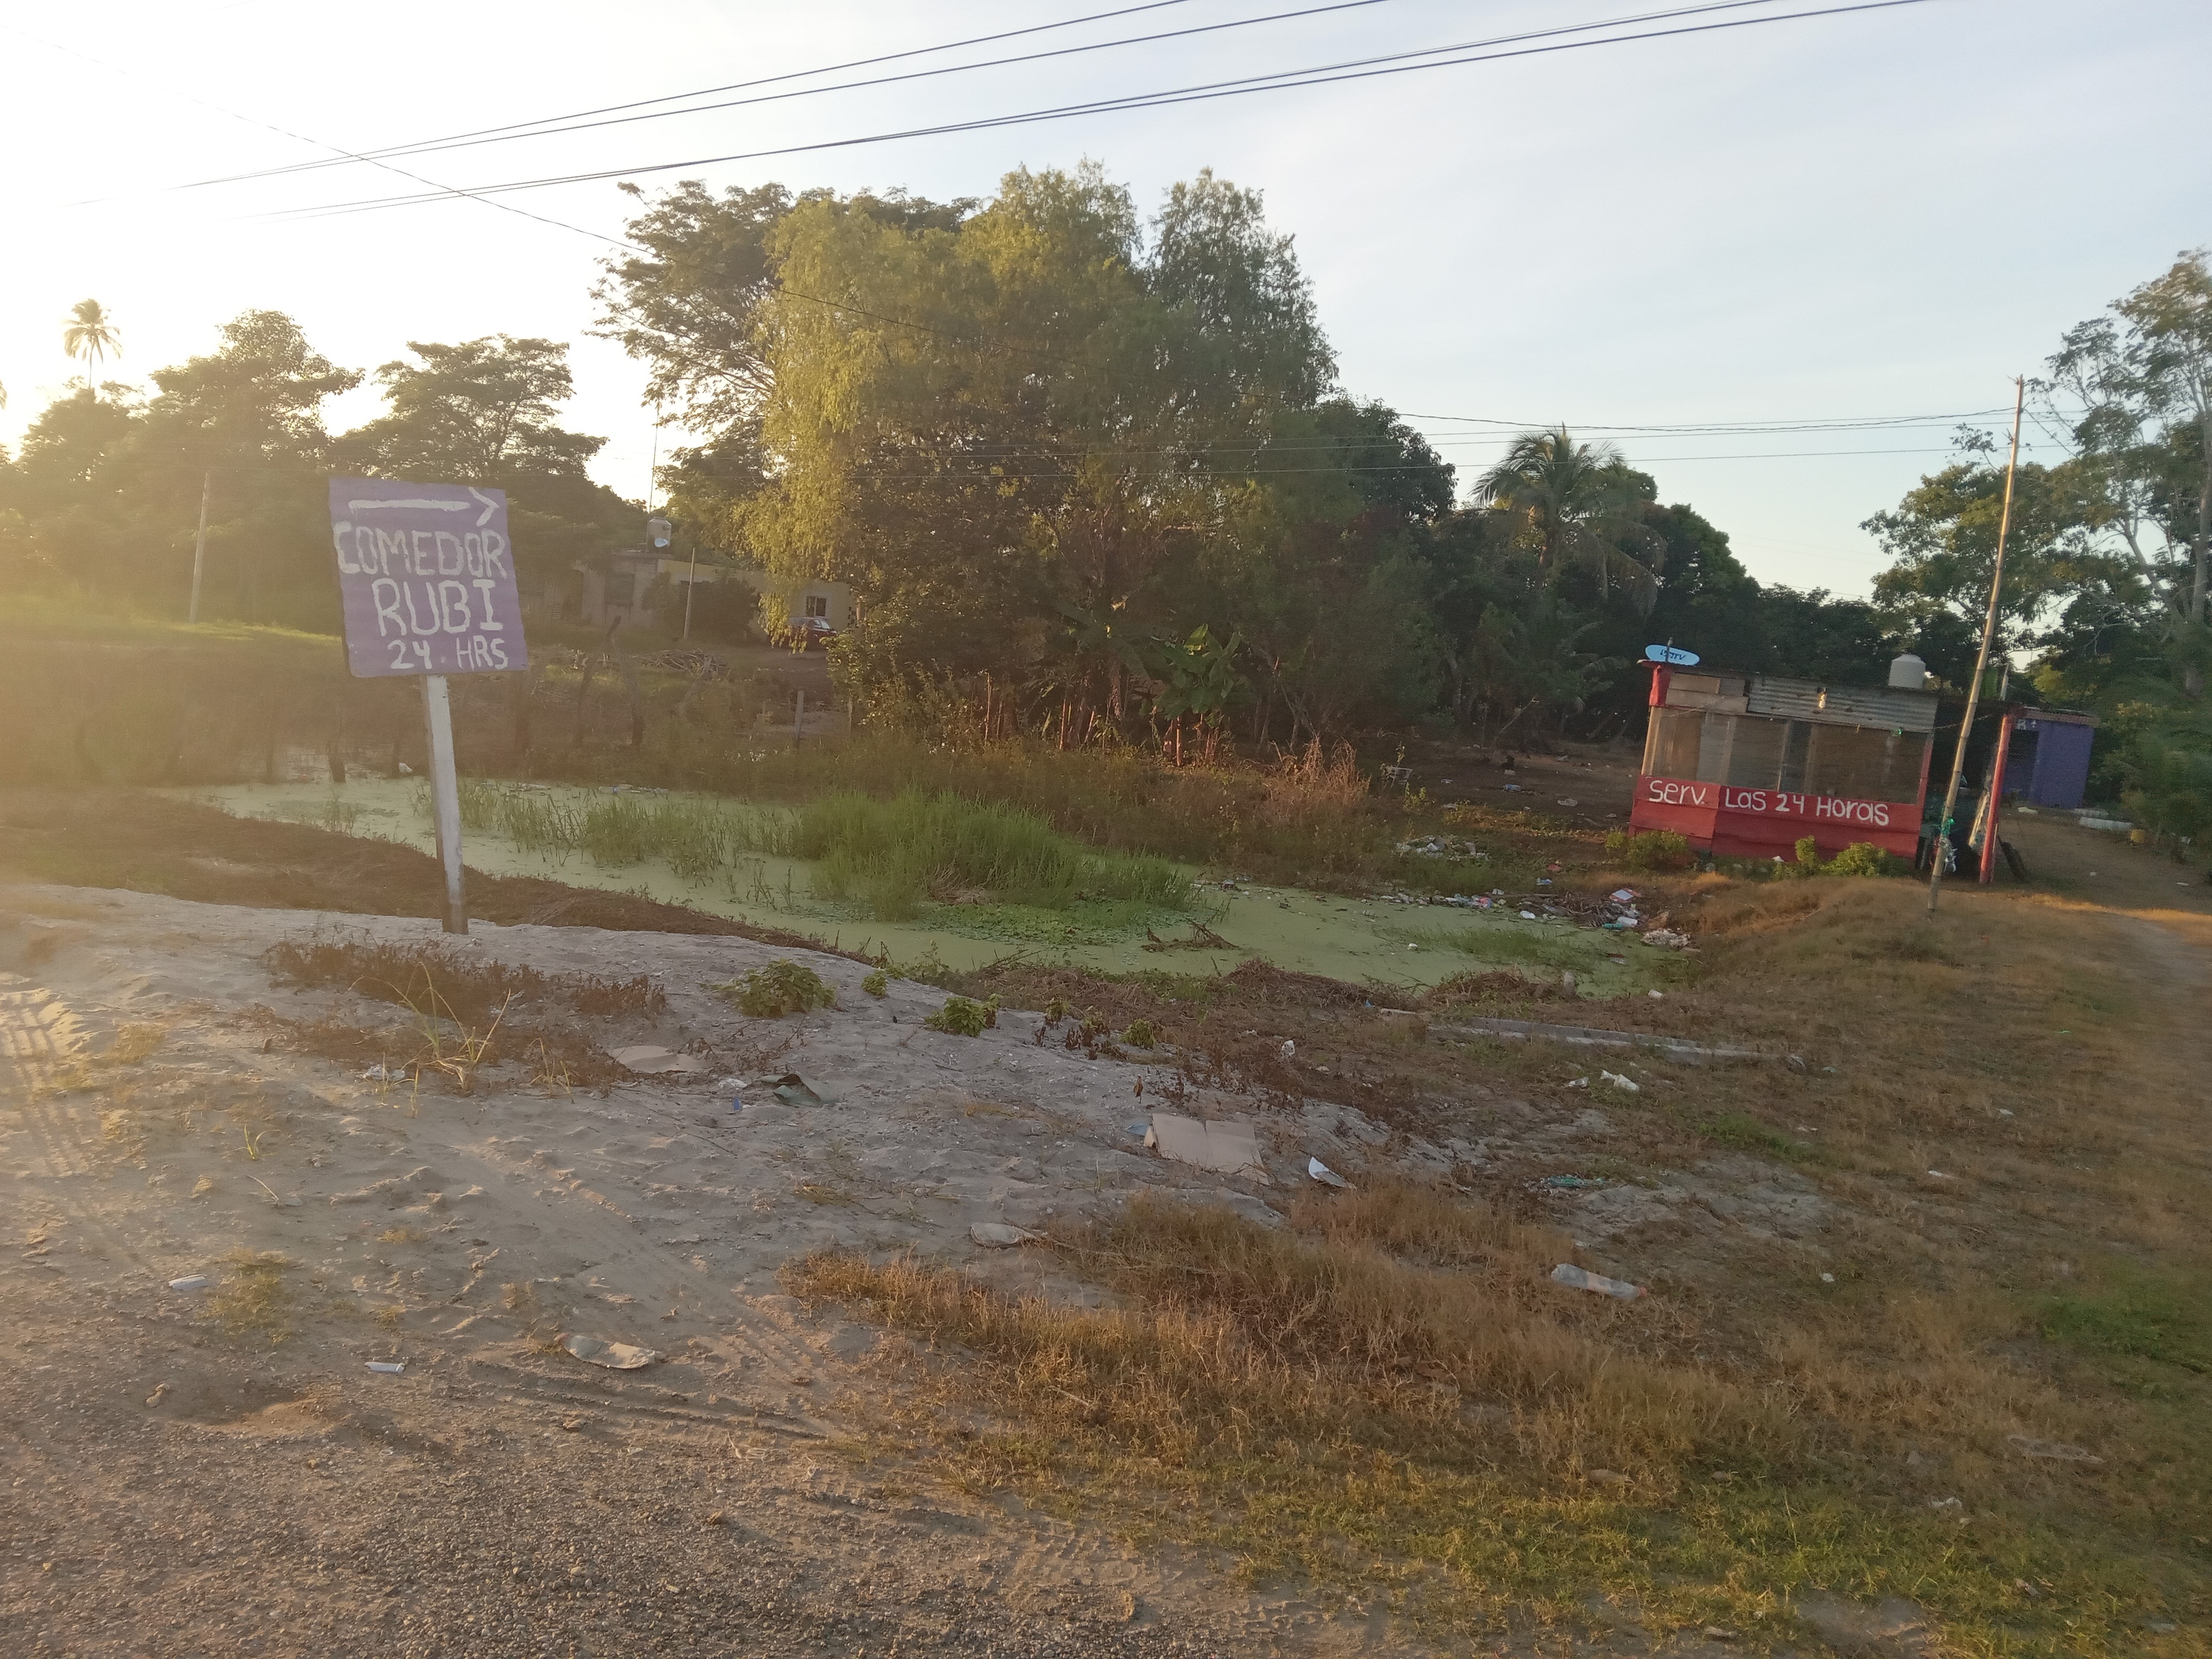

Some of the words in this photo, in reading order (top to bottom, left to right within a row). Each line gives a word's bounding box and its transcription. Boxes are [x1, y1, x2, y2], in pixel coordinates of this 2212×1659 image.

[333, 521, 507, 579] COMEDOR
[372, 578, 503, 636] RUBI
[456, 635, 508, 670] HRS
[1775, 793, 1805, 814] 24
[1816, 796, 1890, 826] Horas
